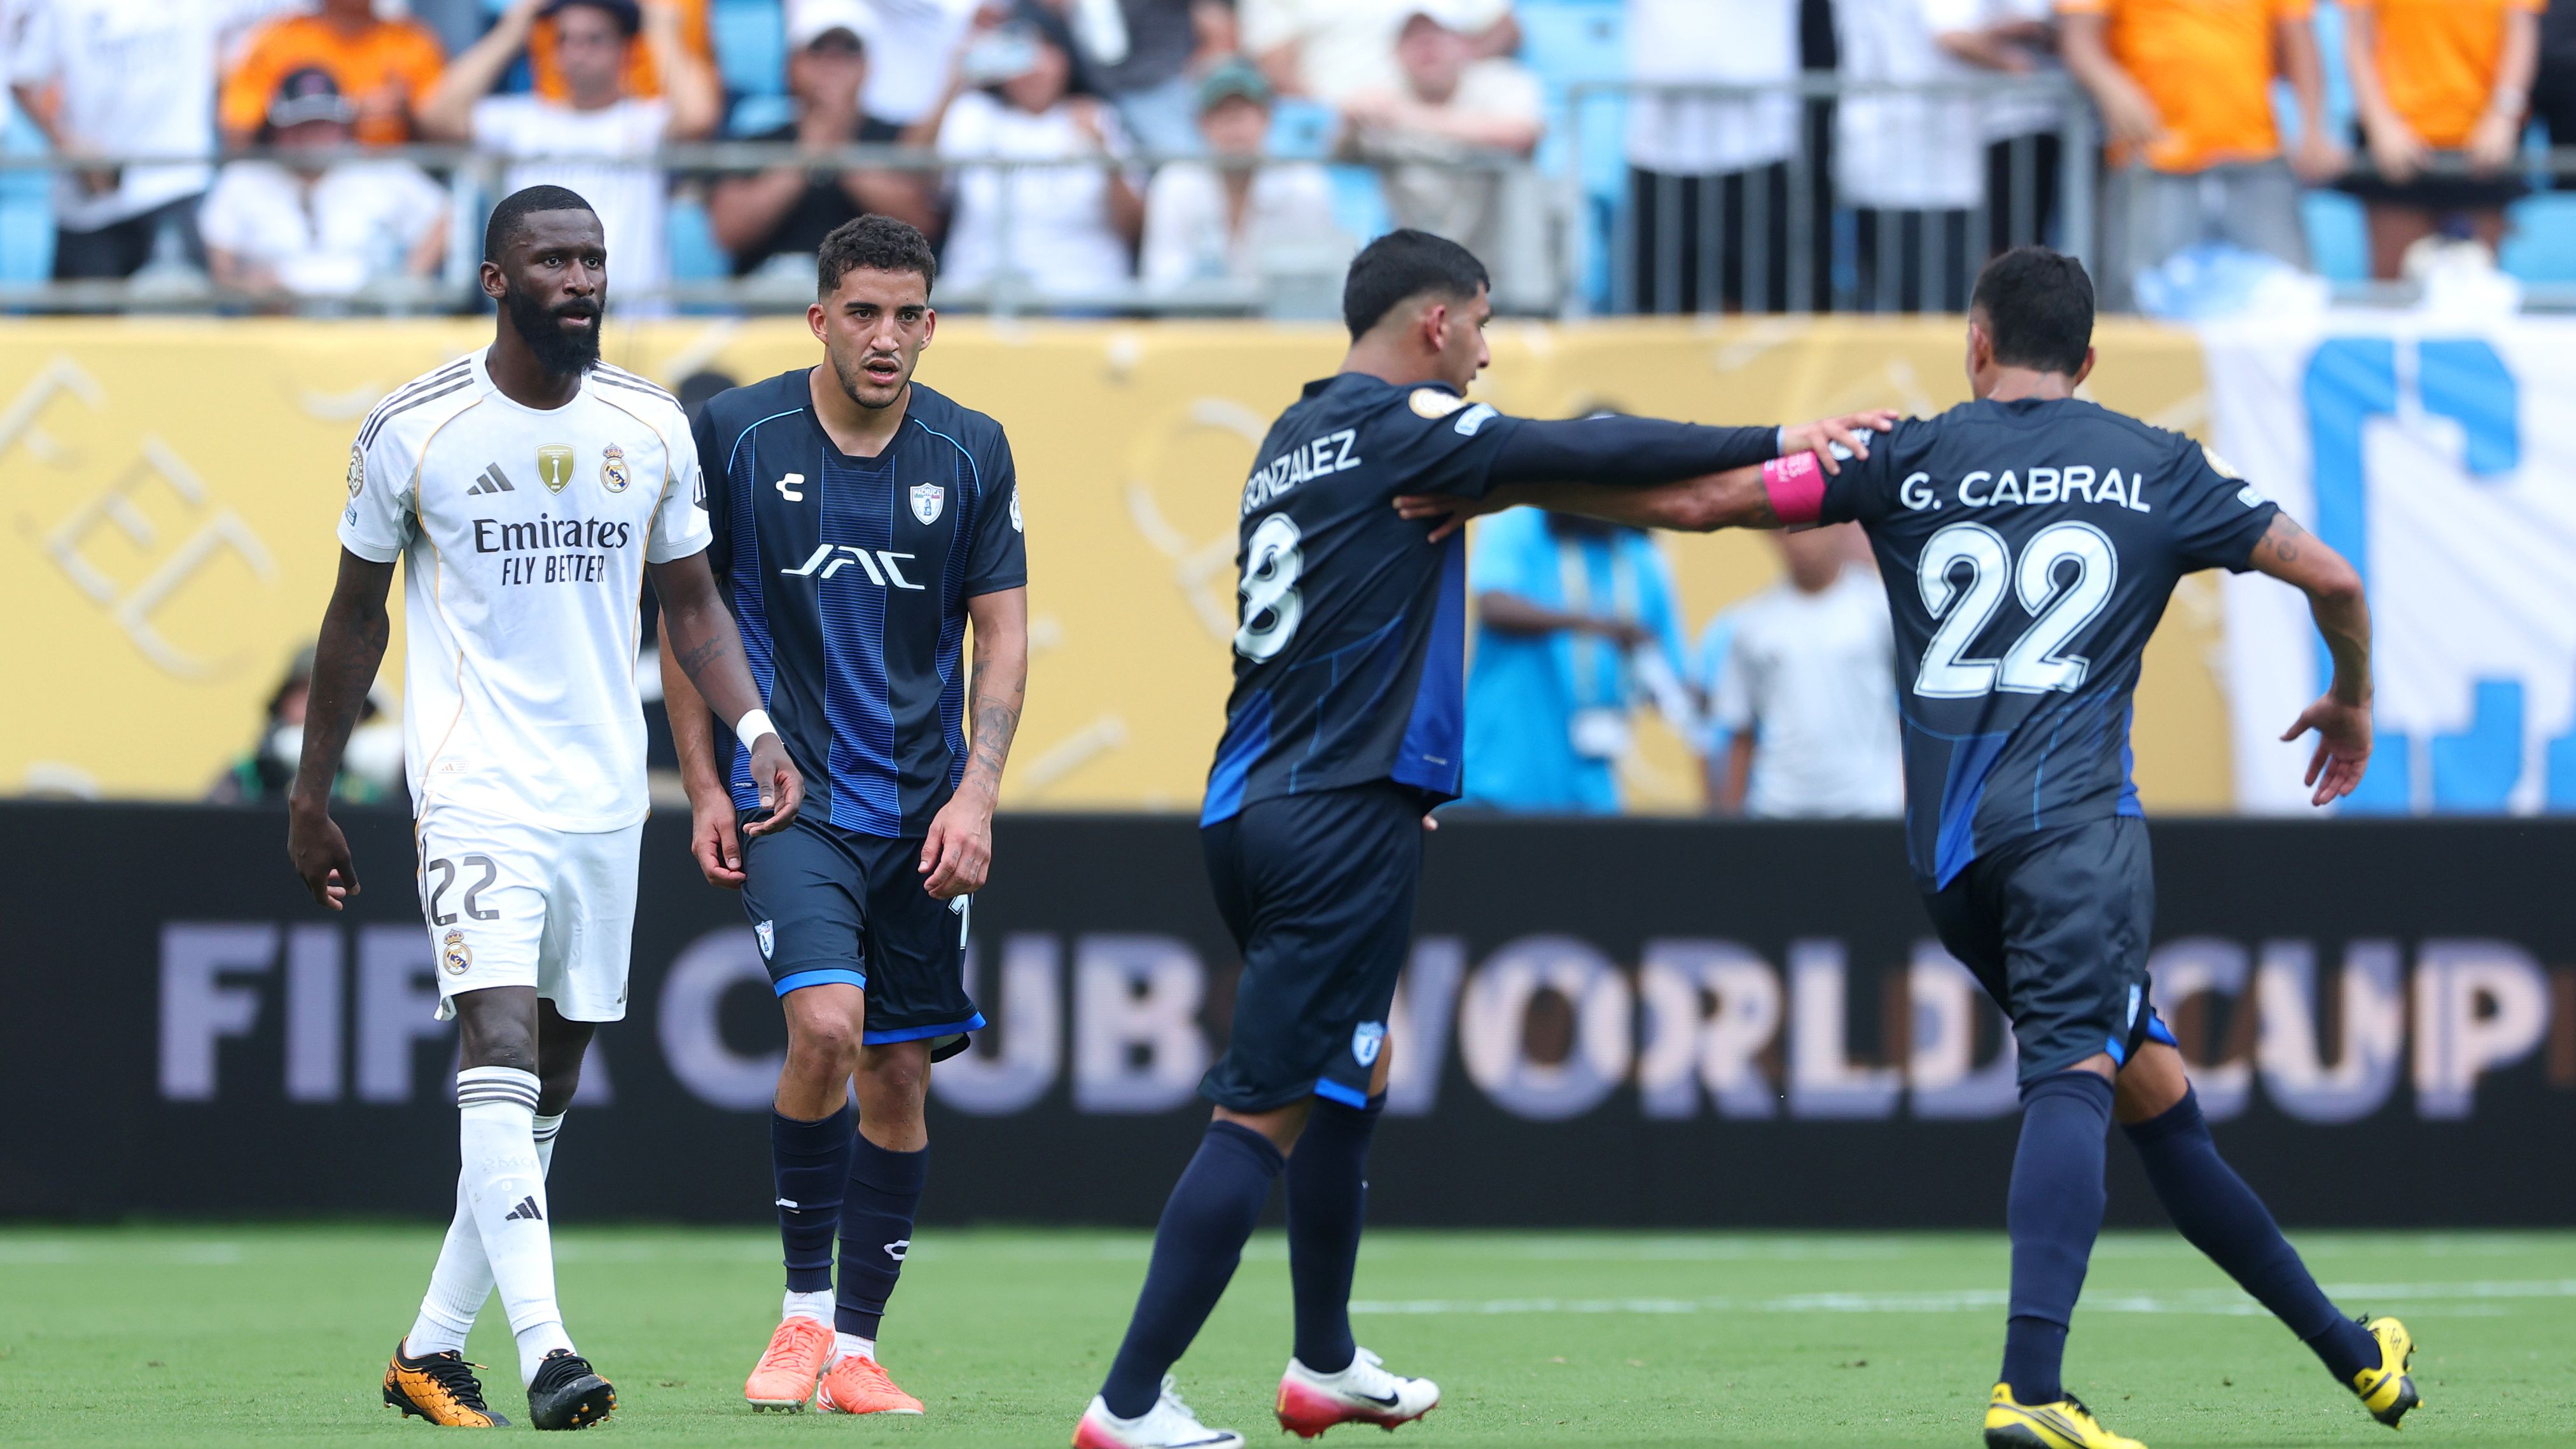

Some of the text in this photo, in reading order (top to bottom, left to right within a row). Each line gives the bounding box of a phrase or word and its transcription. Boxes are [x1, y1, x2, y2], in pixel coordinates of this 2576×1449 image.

[1900, 465, 2152, 513] G. CABRAL
[472, 512, 630, 554] Emirates
[501, 554, 605, 586] FLY BETTER
[781, 543, 926, 590] JAC
[1913, 519, 2119, 699] 22
[428, 856, 500, 927] 22
[949, 892, 973, 950] 1
[657, 922, 1214, 1116] CUB
